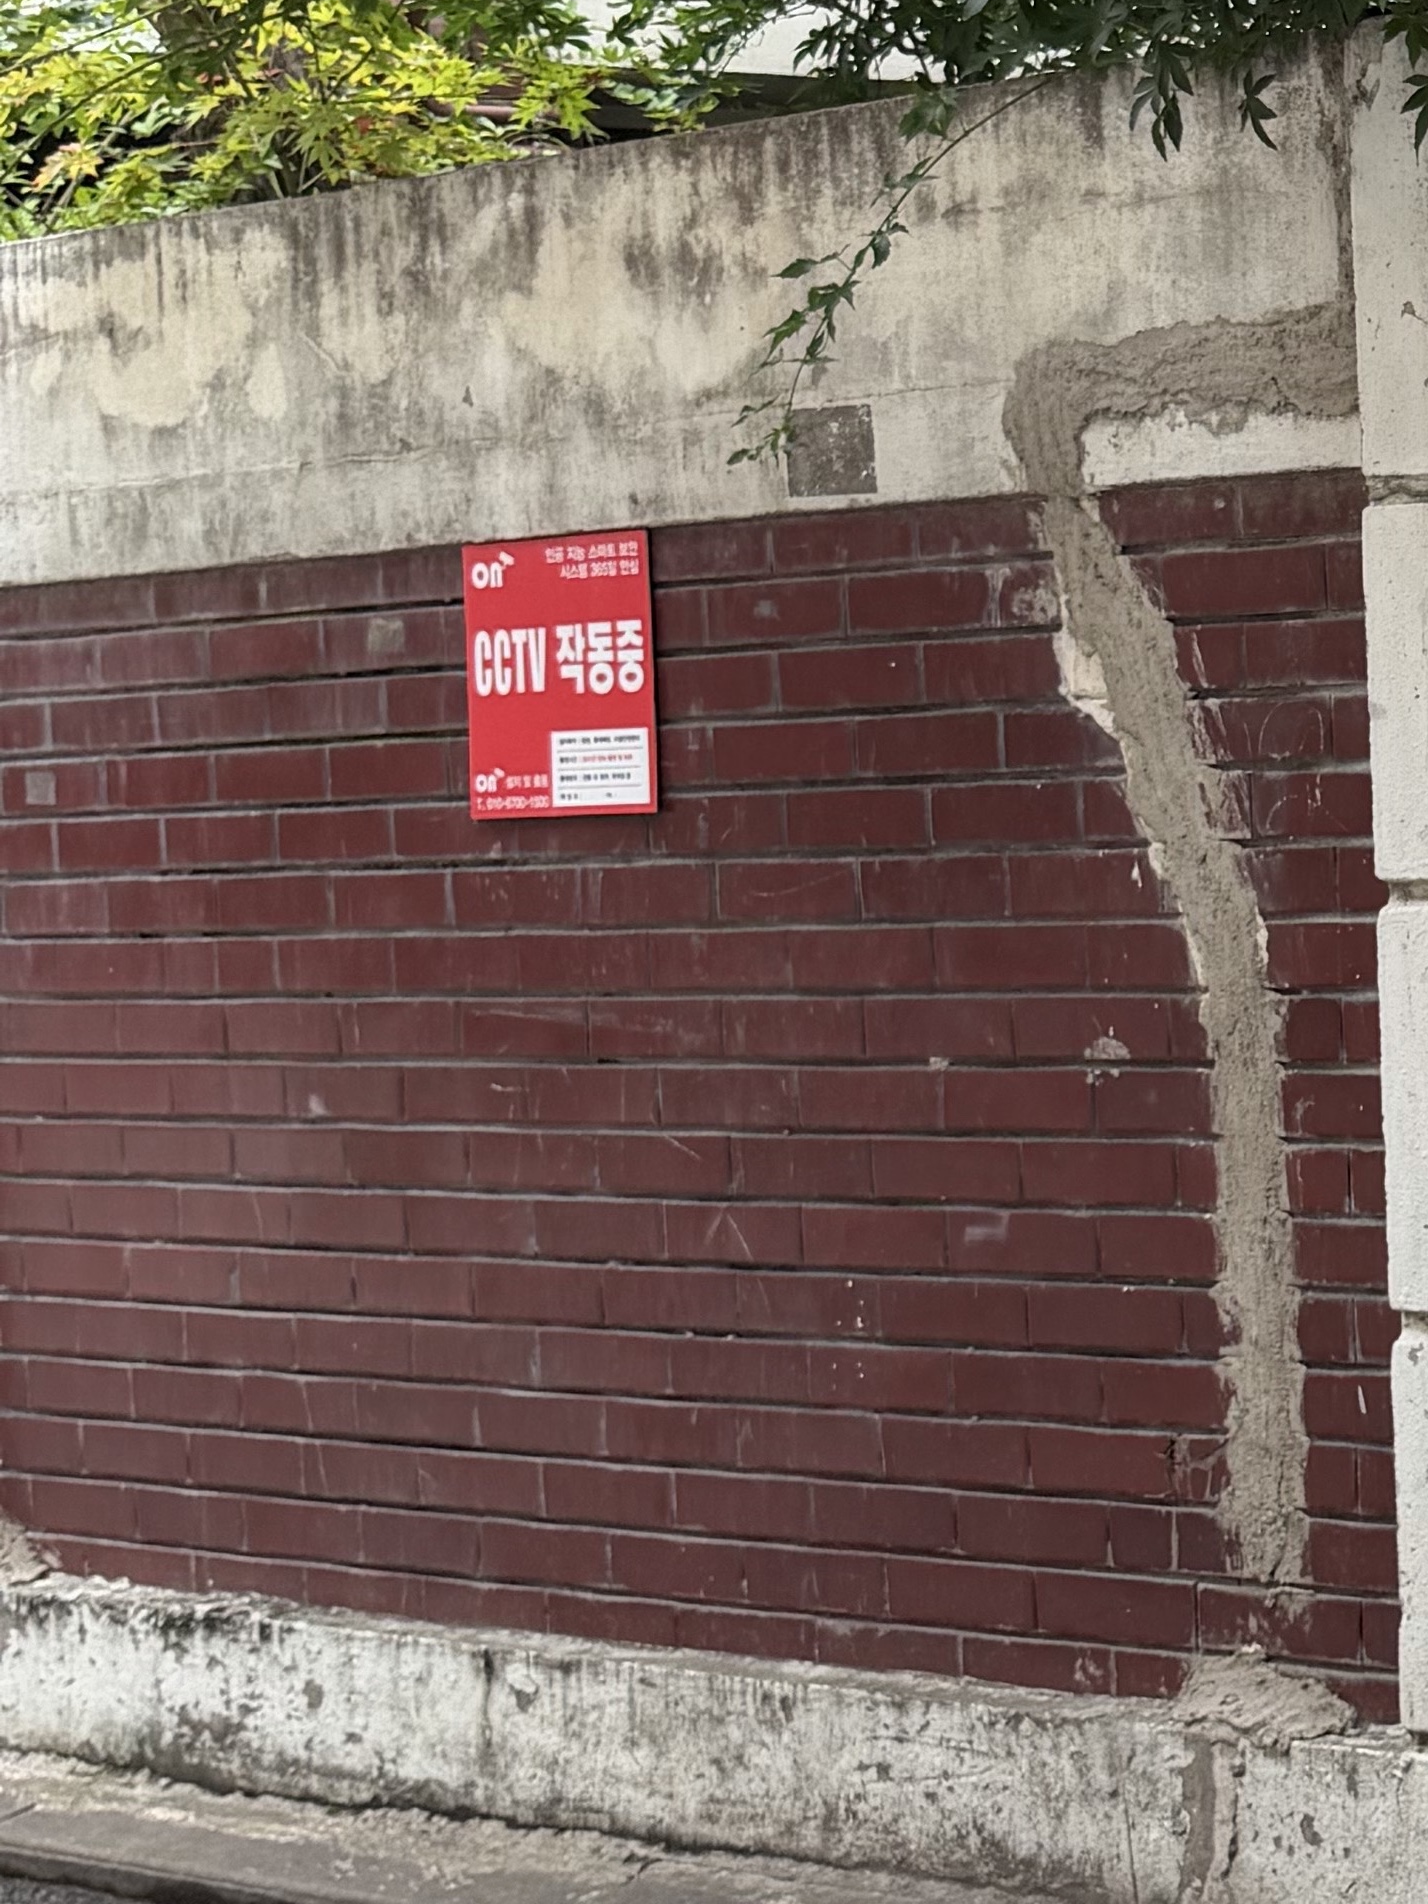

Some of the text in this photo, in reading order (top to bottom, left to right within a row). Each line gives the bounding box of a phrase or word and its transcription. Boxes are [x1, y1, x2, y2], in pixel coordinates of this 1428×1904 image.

[471, 561, 504, 589] on
[560, 562, 588, 579] 시스템
[474, 619, 645, 696] CCTV 작동중
